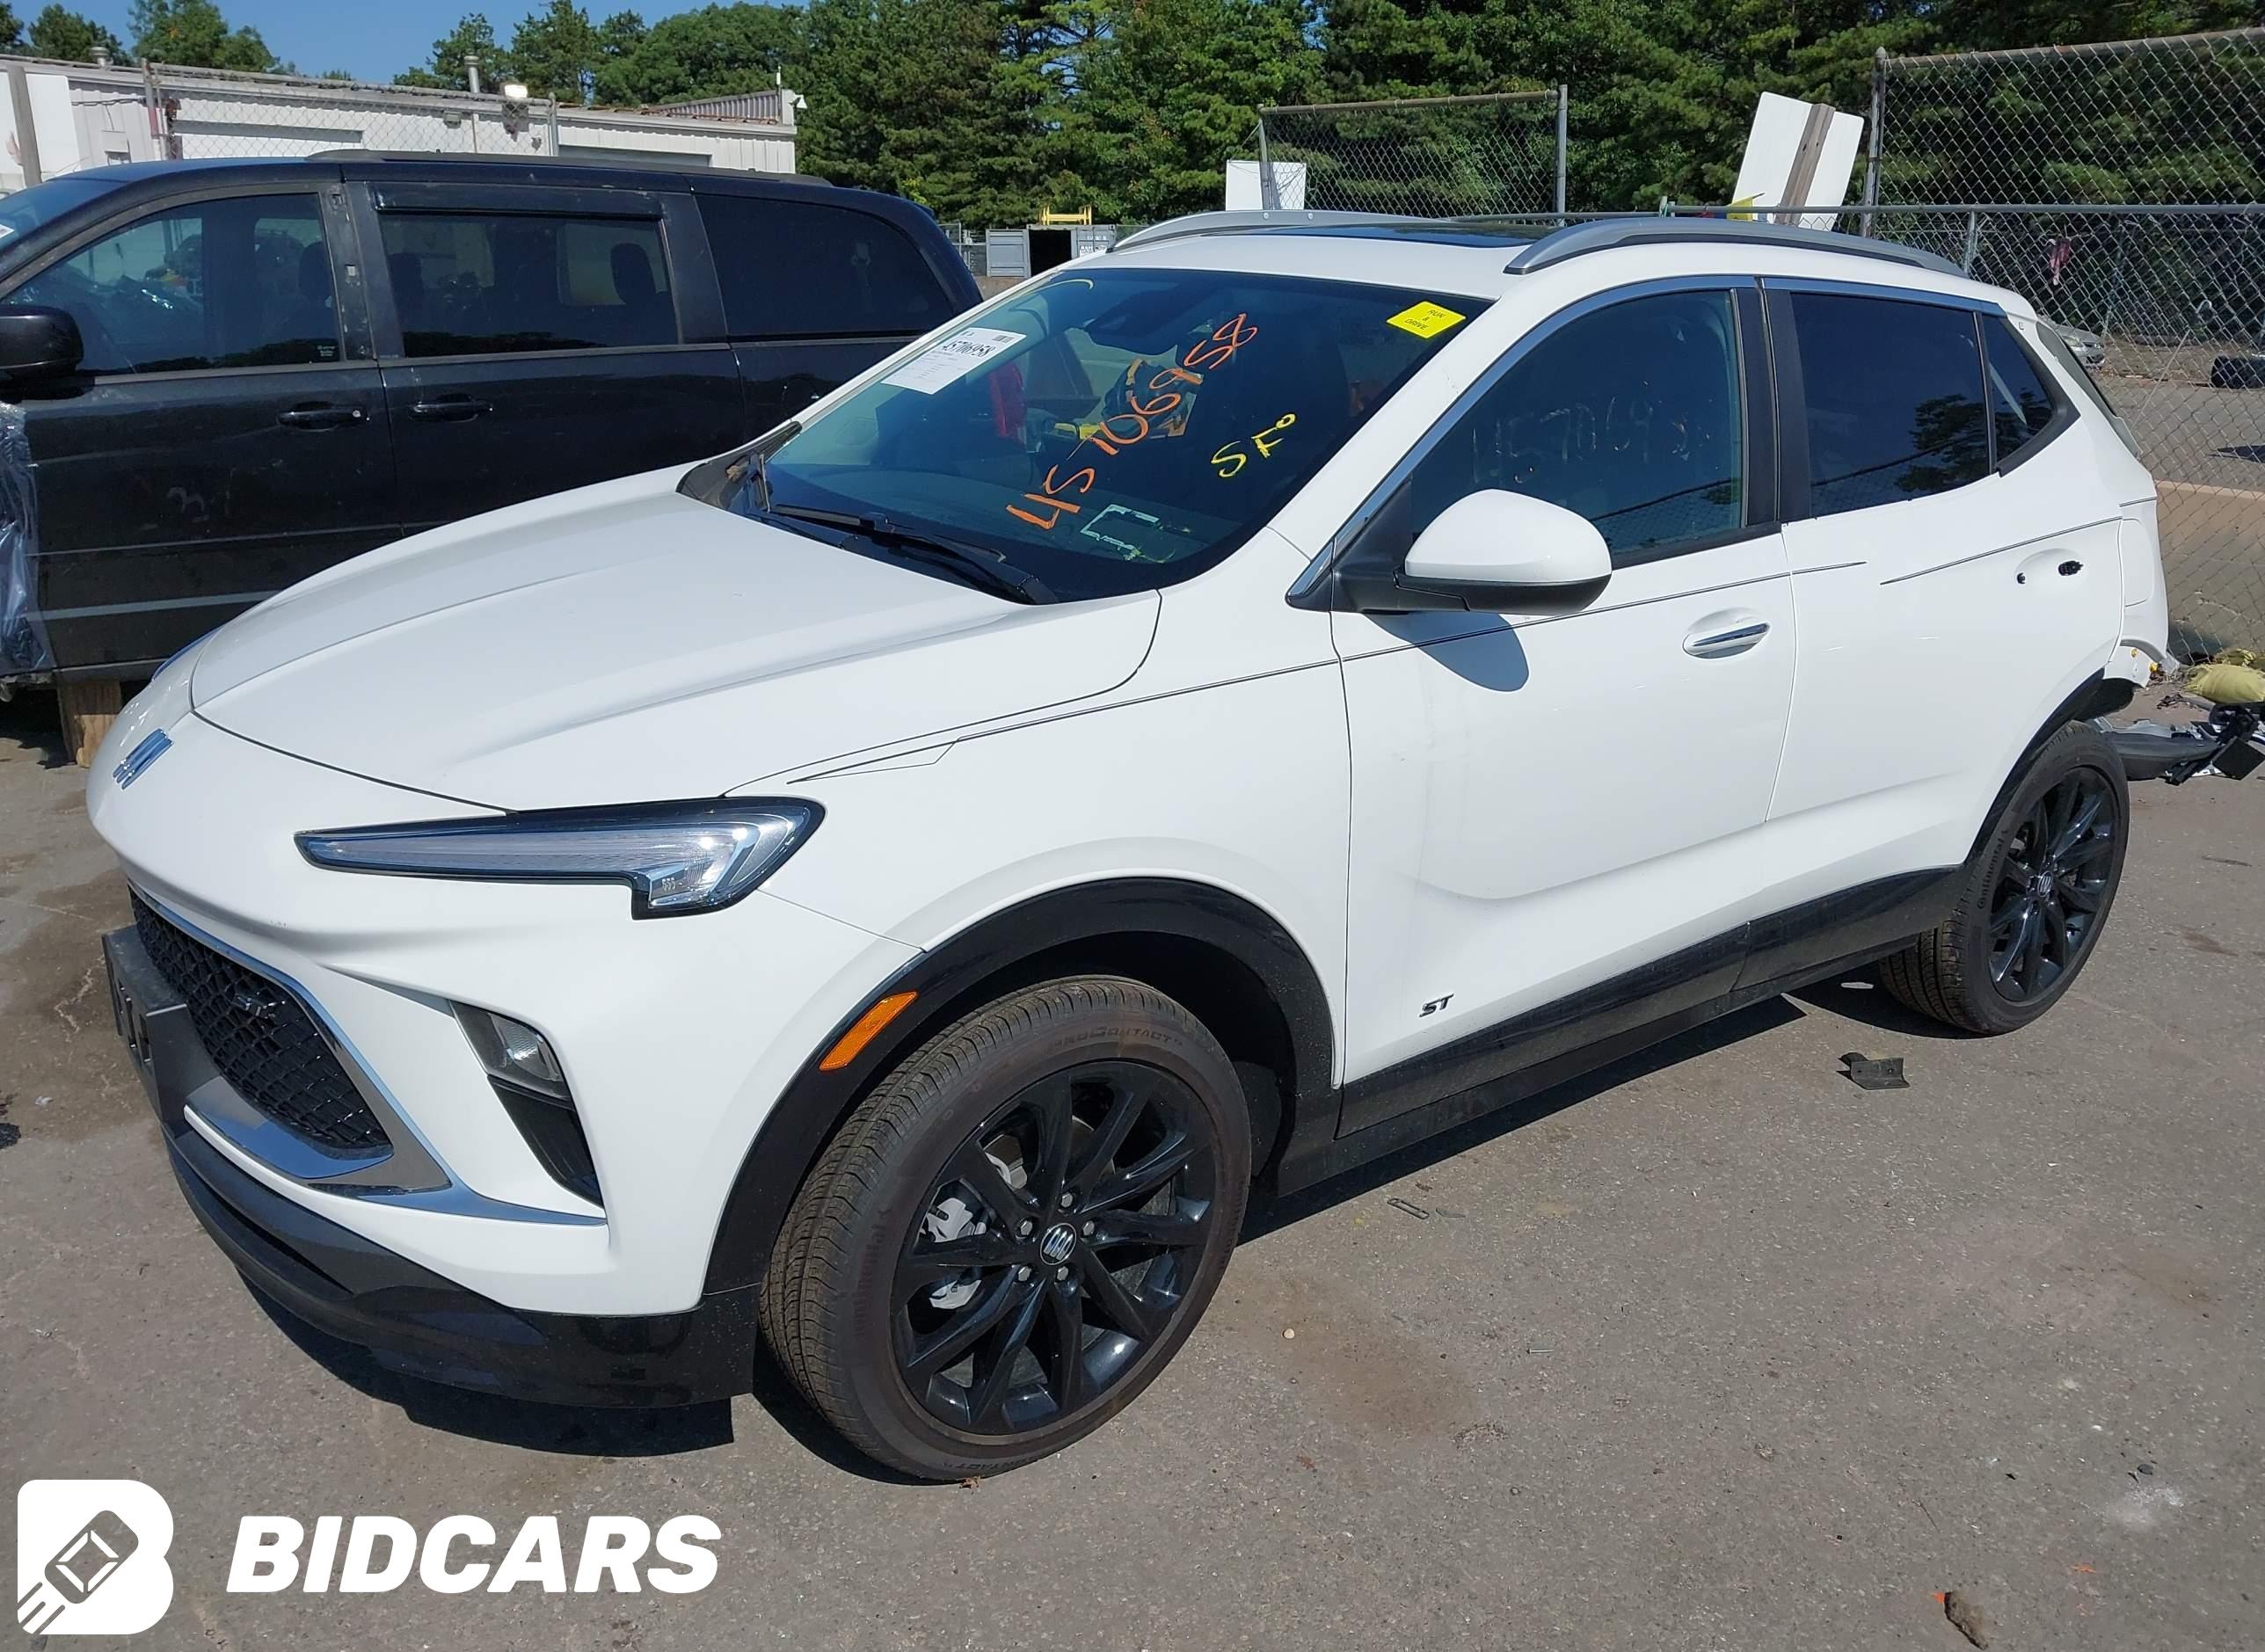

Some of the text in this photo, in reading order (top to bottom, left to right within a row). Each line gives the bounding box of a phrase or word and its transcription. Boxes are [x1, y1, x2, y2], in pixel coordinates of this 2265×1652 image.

[1428, 309, 1446, 318] RUN
[1404, 318, 1428, 331] DRIVE
[1419, 993, 1454, 1017] ST
